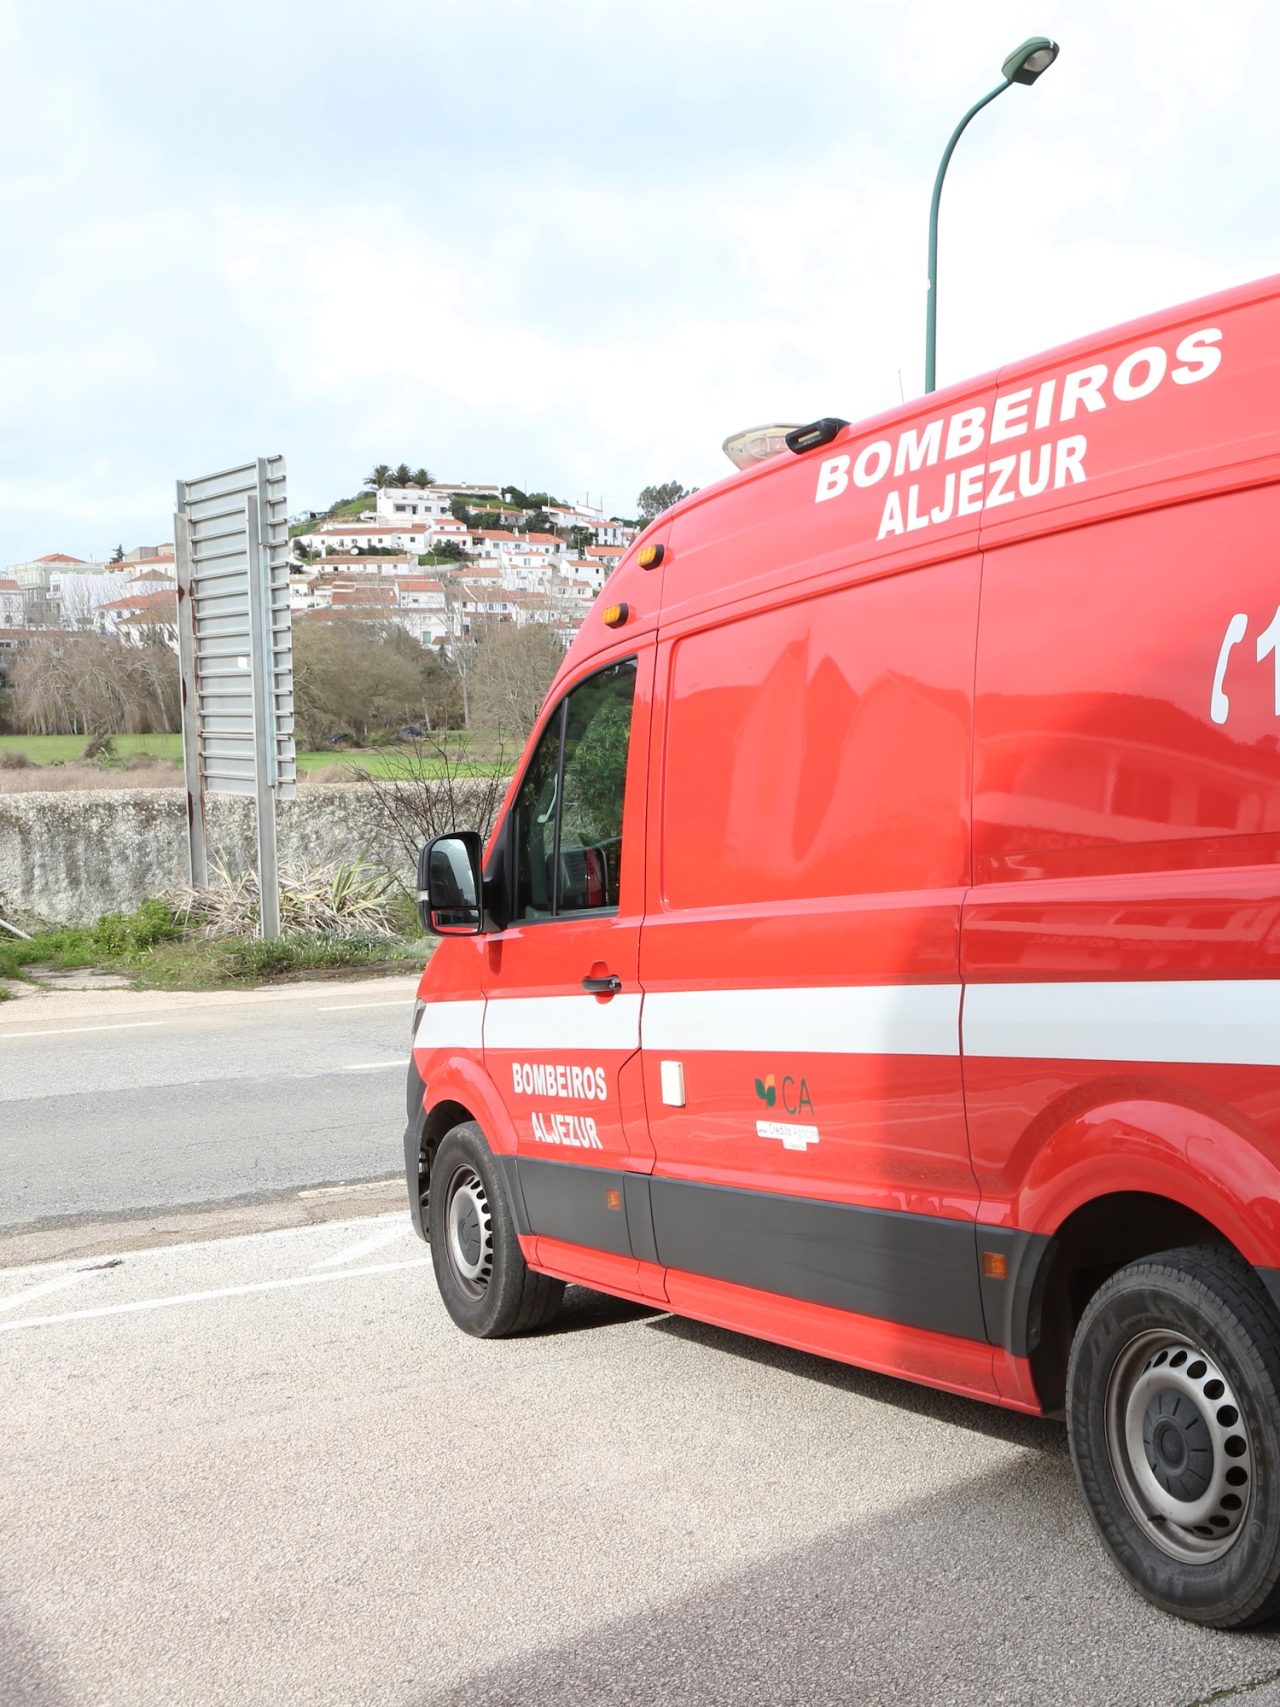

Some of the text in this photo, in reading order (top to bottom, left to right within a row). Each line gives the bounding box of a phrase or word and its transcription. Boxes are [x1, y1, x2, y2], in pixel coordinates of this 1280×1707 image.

[814, 328, 1224, 503] BOMBEIROS
[875, 433, 1088, 541] ALJEZUR
[511, 1062, 608, 1101] BOMBEIROS
[782, 1074, 815, 1118] CA
[531, 1111, 604, 1150] ALJEZUR
